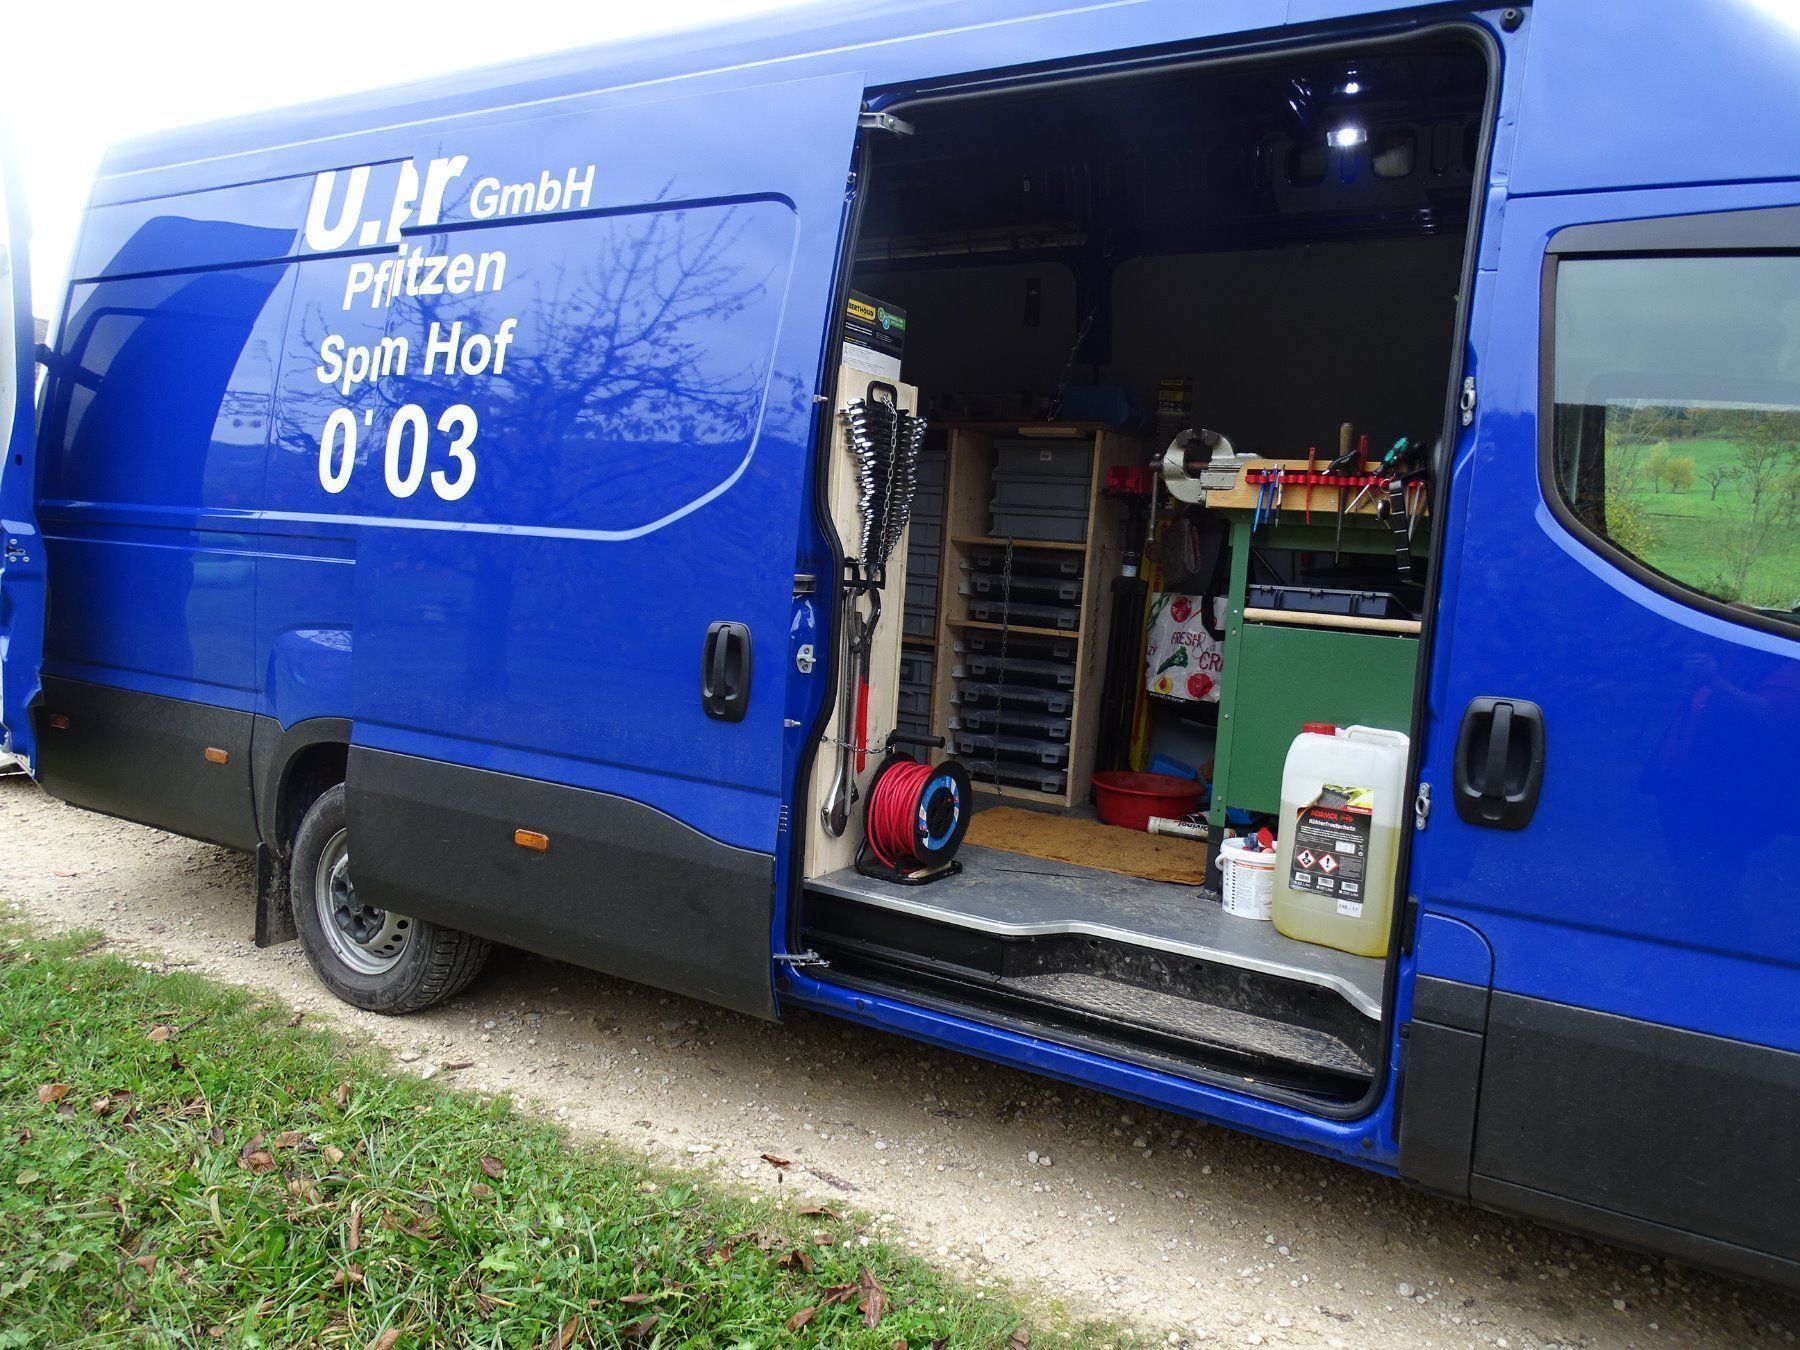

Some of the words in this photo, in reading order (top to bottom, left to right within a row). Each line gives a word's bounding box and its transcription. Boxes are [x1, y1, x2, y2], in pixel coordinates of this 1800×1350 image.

[469, 165, 596, 219] GmbH
[848, 303, 874, 316] BERTHOUD
[424, 318, 518, 375] Hof
[1171, 632, 1202, 646] FRESH
